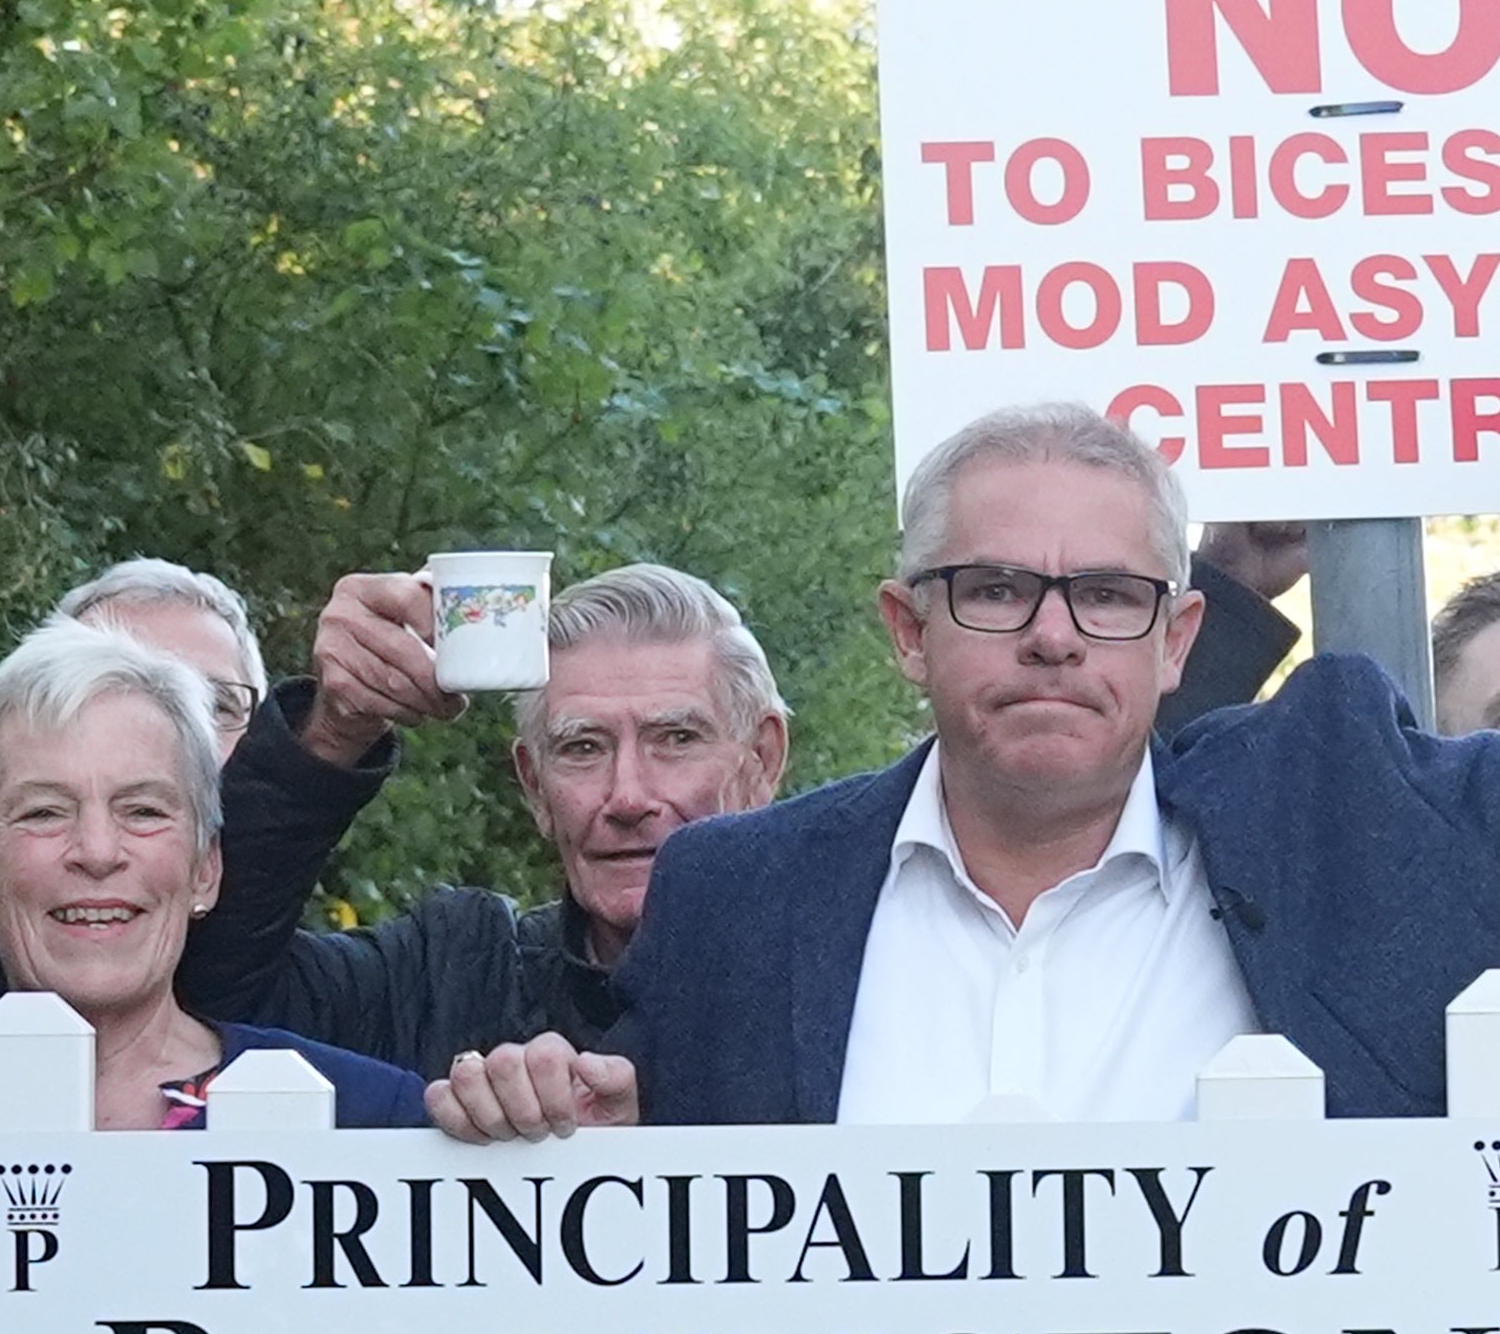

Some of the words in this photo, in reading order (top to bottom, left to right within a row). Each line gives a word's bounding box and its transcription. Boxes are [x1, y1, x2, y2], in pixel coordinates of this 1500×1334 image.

[920, 136, 1090, 226] TO
[922, 260, 1216, 352] MOD
[191, 1160, 1213, 1292] PRINCIPALITY
[1262, 1179, 1393, 1278] of
